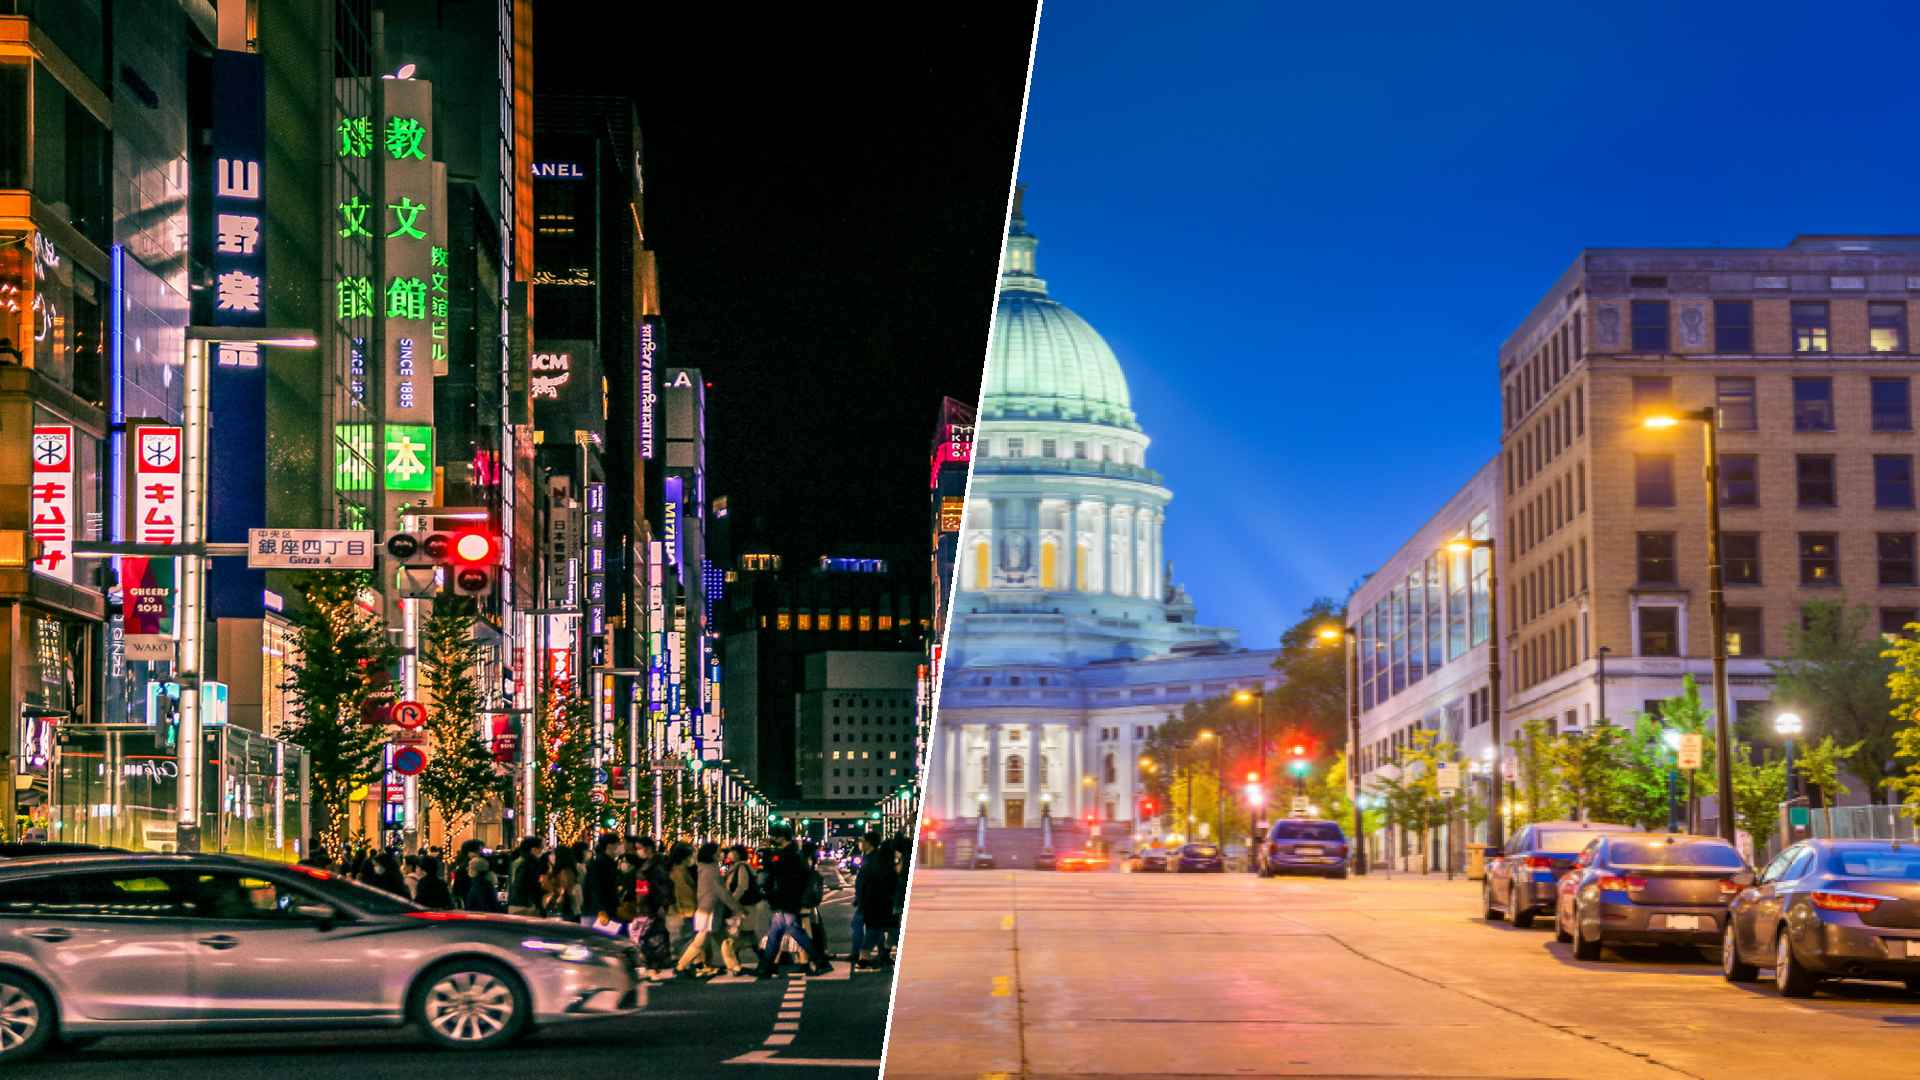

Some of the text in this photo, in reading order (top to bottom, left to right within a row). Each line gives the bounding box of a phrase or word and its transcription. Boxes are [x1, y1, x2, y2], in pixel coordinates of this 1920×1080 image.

[385, 115, 428, 320] 教文館
[218, 158, 260, 366] 山野楽器
[431, 245, 448, 361] 教文館ビル
[400, 338, 413, 408] SINCE 1885
[386, 436, 427, 481] 本
[144, 483, 175, 545] キムラ
[258, 530, 291, 538] 中央区
[258, 539, 365, 556] 銀座四丁目
[289, 556, 332, 564] Ginza 4
[130, 588, 169, 596] CHEERS
[137, 604, 163, 612] 2021
[133, 643, 168, 652] WAKO
